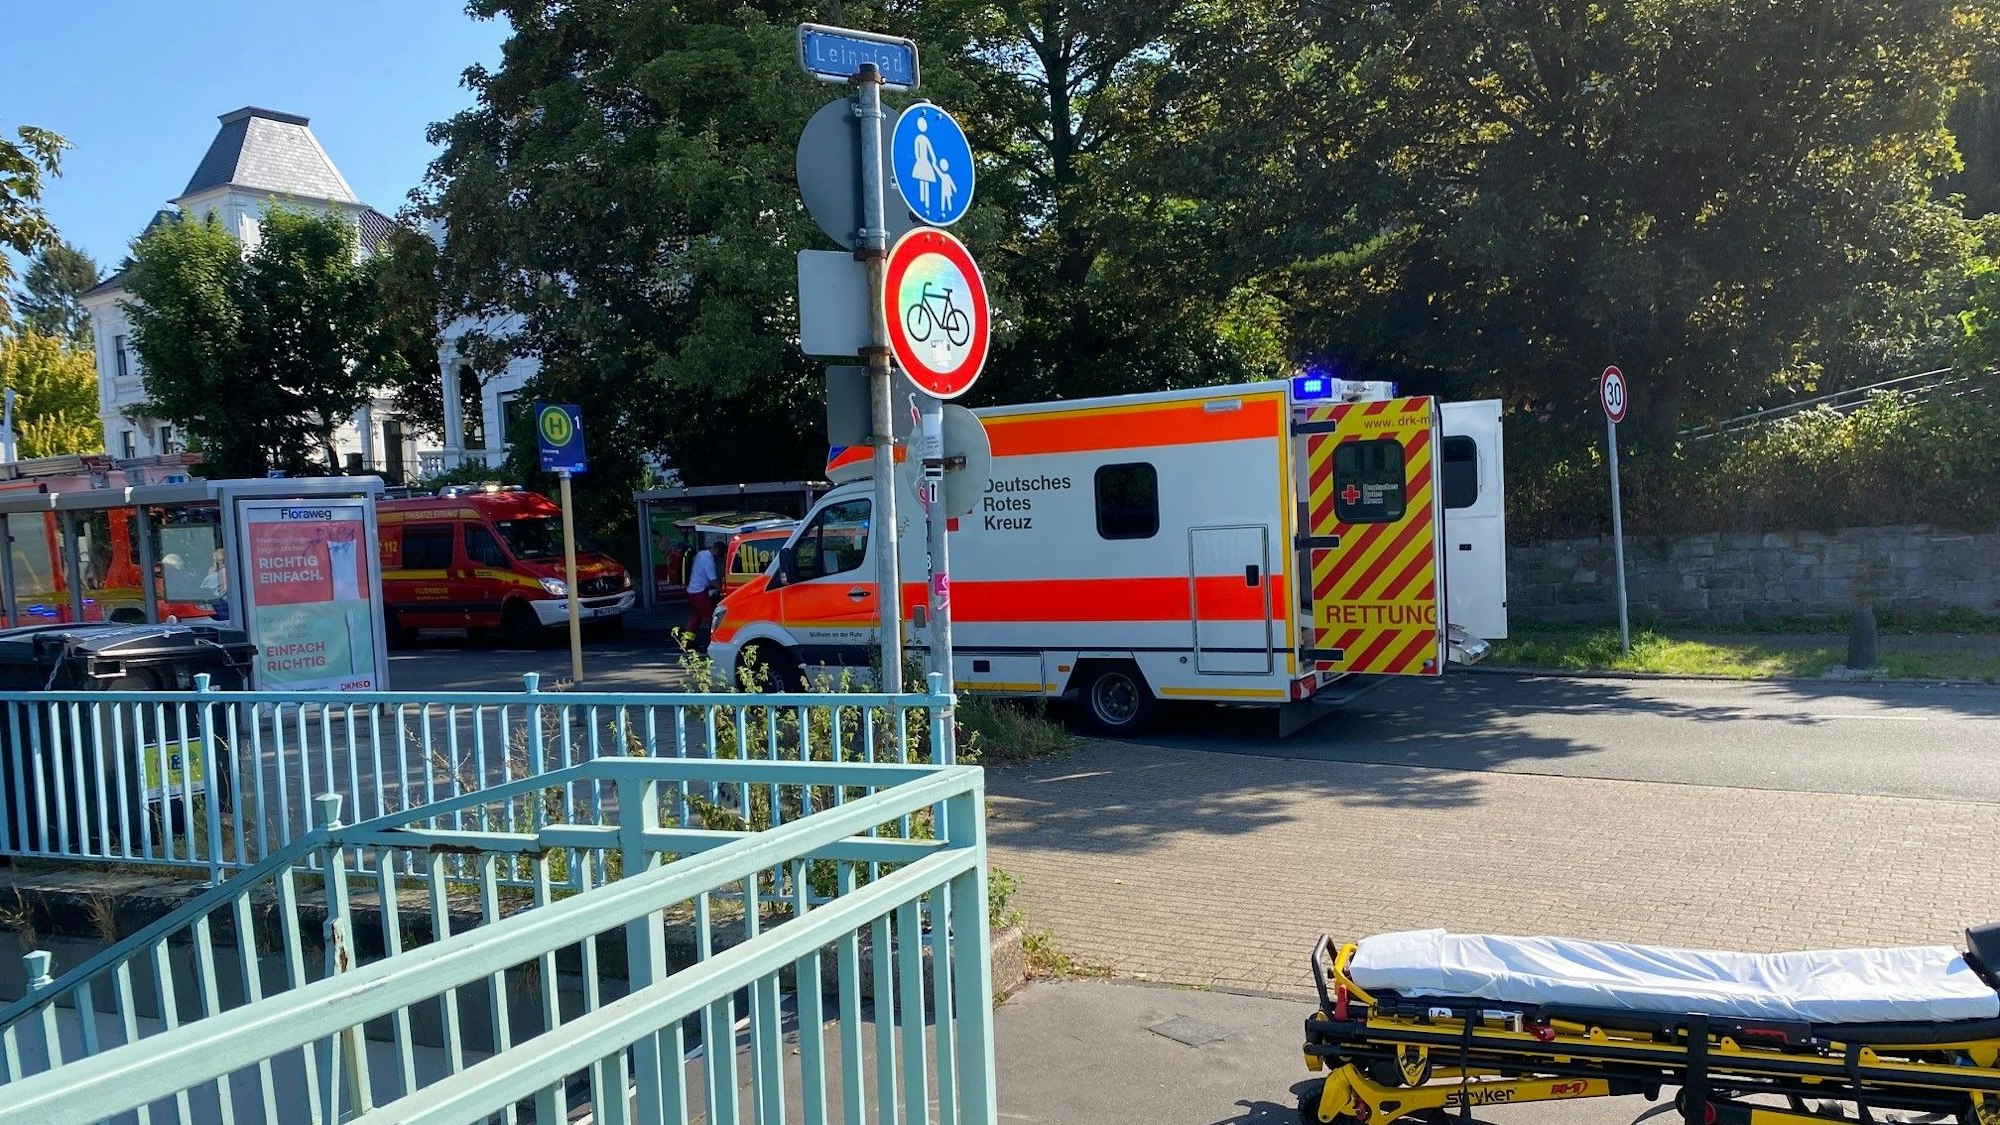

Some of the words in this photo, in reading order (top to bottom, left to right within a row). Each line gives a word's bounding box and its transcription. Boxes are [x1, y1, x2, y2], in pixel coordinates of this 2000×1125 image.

[1606, 382, 1622, 406] 30
[549, 416, 563, 435] H
[574, 415, 581, 430] 1
[984, 475, 1071, 493] Deutsches
[983, 496, 1031, 512] Rotes
[280, 508, 332, 520] Floraweg
[984, 515, 1032, 531] Kreuz
[384, 540, 398, 553] 112
[258, 555, 318, 569] RICHTIG
[260, 570, 324, 584] EINFACH.
[266, 641, 325, 658] EINFACH
[267, 655, 330, 672] RICHTIG.
